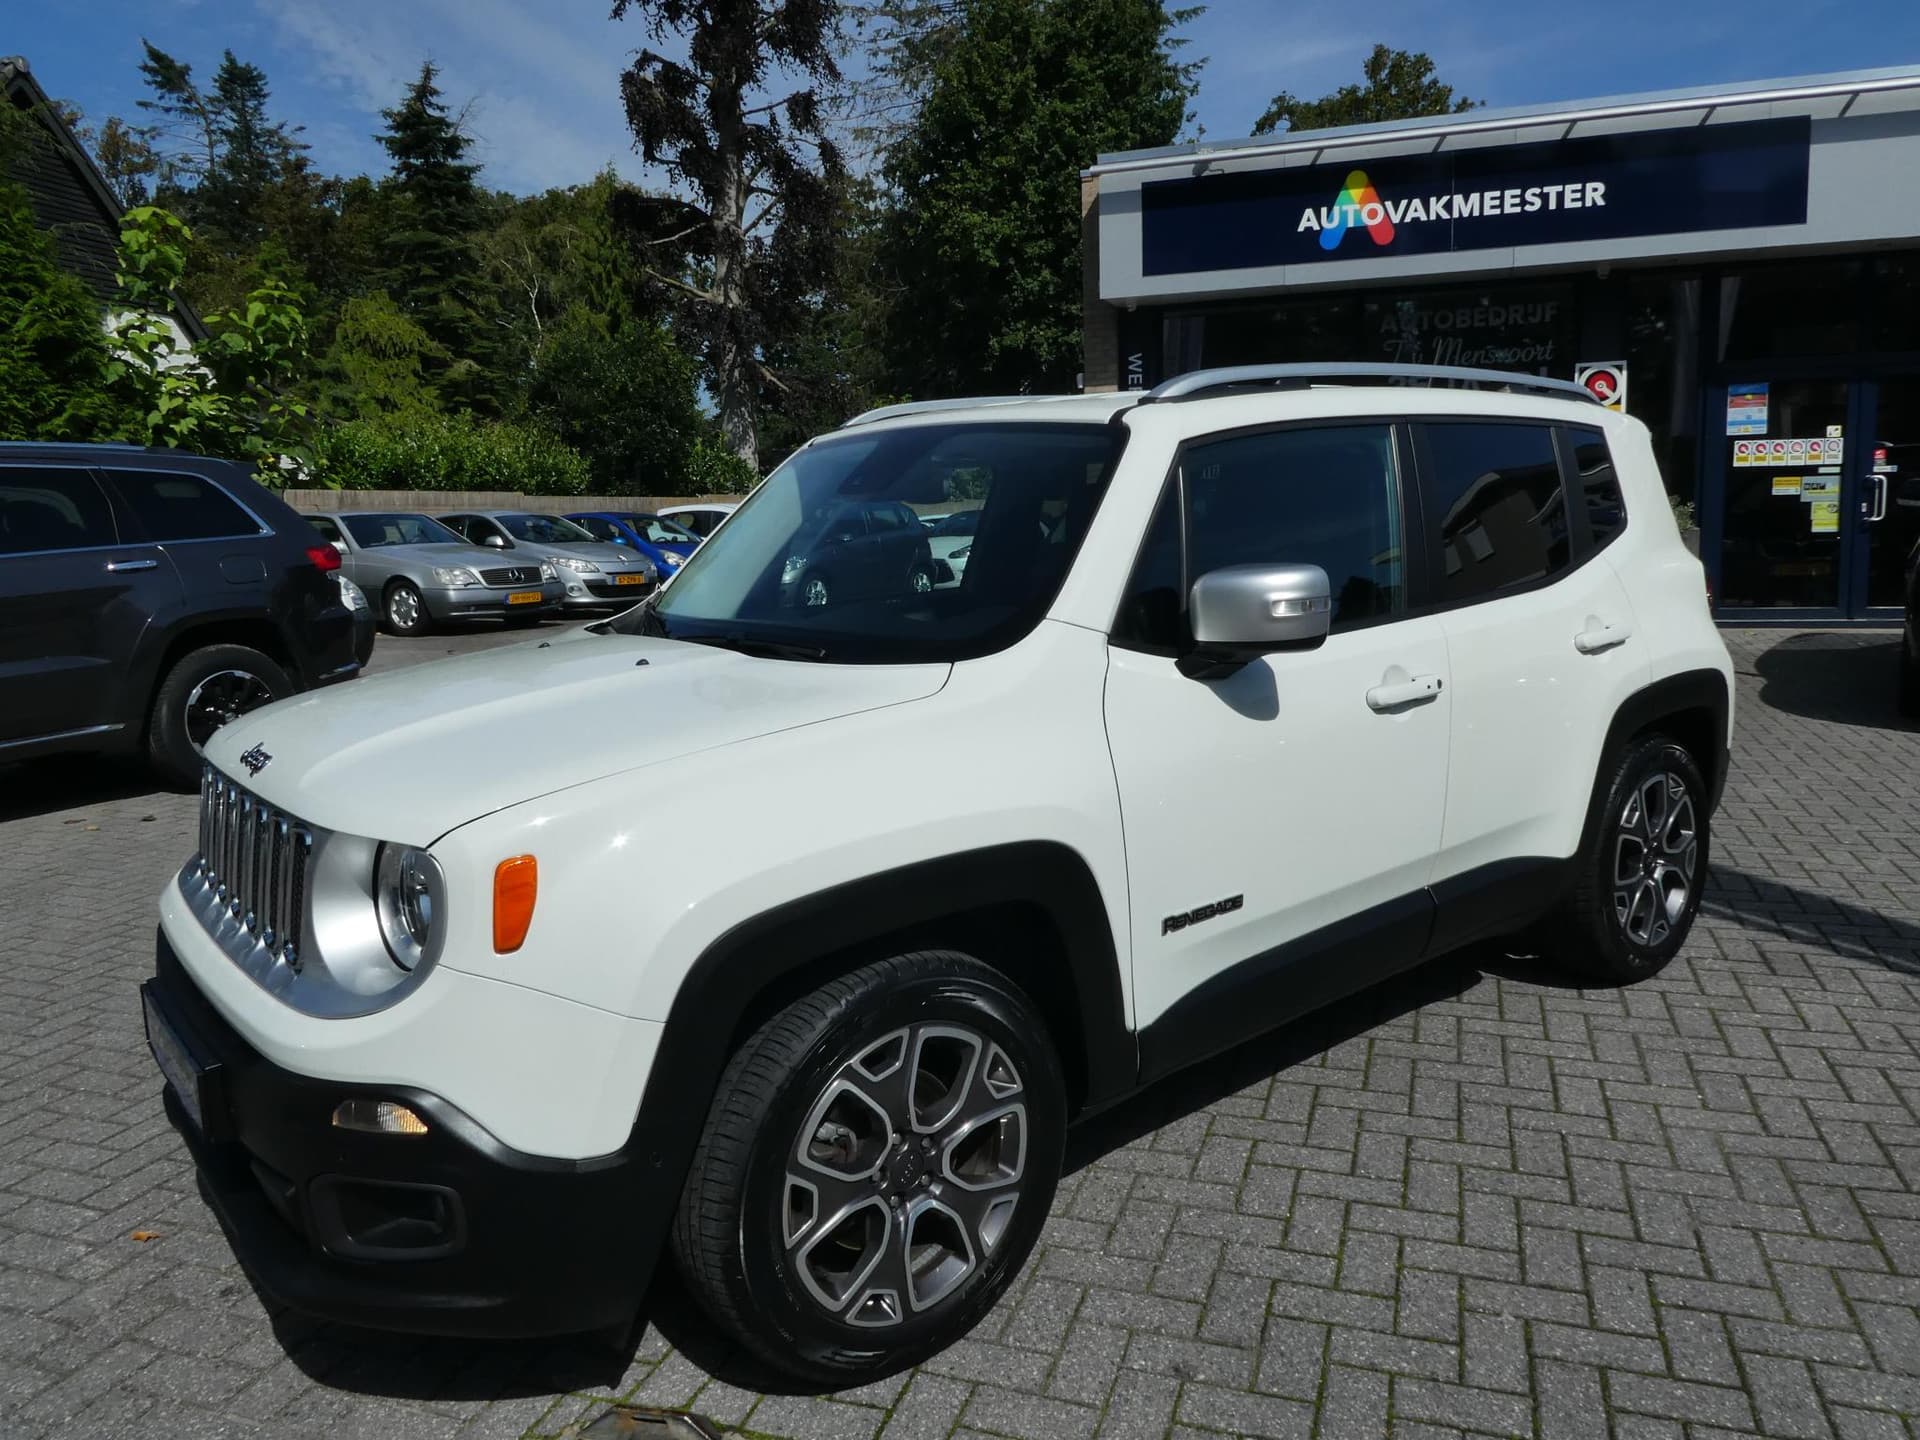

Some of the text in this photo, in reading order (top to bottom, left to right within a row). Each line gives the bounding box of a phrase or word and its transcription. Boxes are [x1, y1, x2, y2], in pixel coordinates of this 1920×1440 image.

[1297, 181, 1606, 232] AUTOVAKMEESTER
[1380, 301, 1560, 333] AUTOBEDRIJF
[1128, 353, 1143, 391] WE
[1161, 894, 1244, 936] RENEGADE
